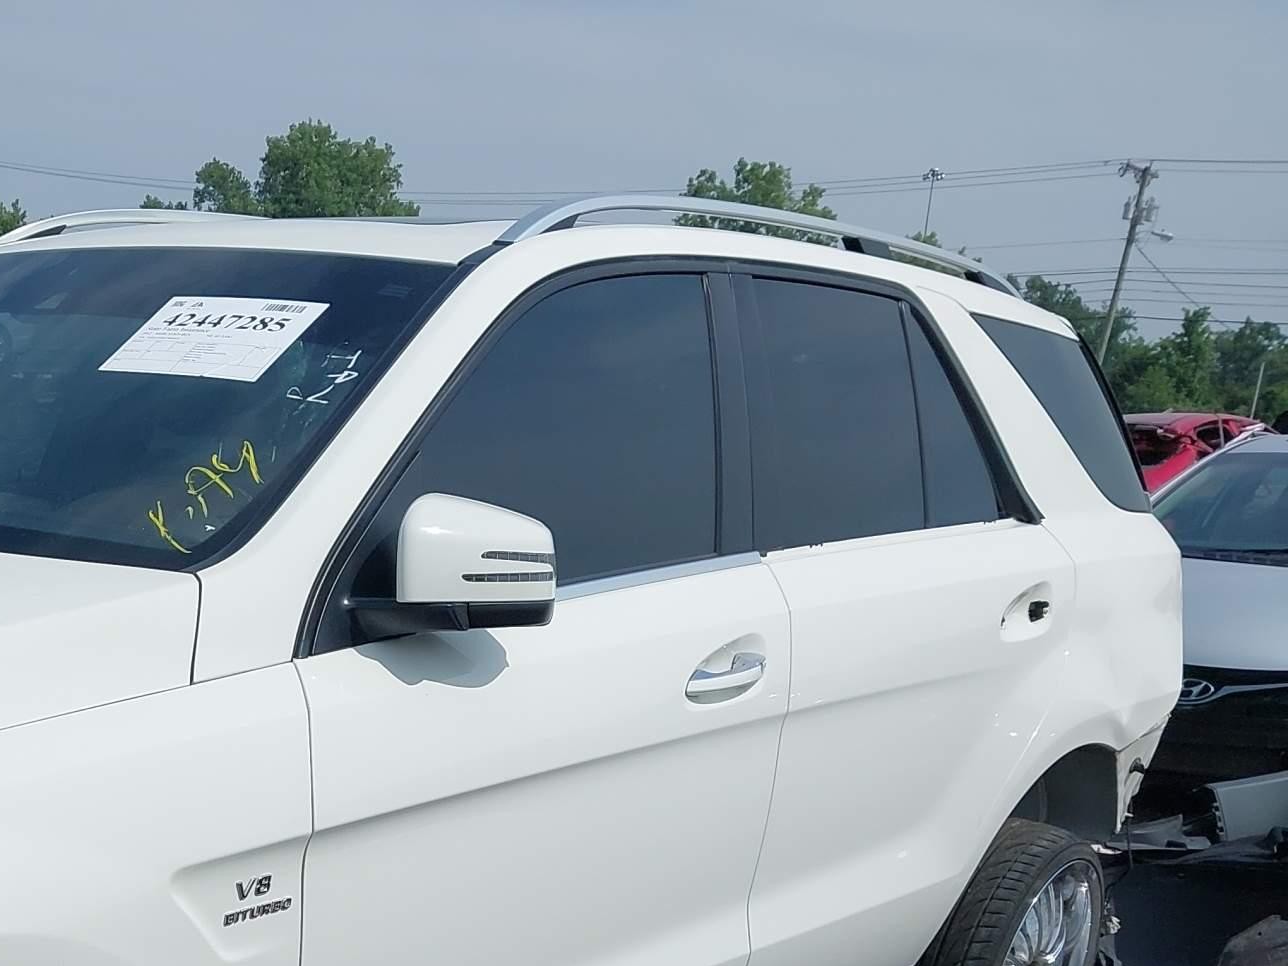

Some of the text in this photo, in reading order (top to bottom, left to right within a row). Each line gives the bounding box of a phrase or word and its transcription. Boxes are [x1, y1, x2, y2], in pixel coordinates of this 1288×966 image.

[163, 312, 292, 332] 42447285
[236, 874, 272, 901] V8
[223, 898, 292, 927] BITURBO
